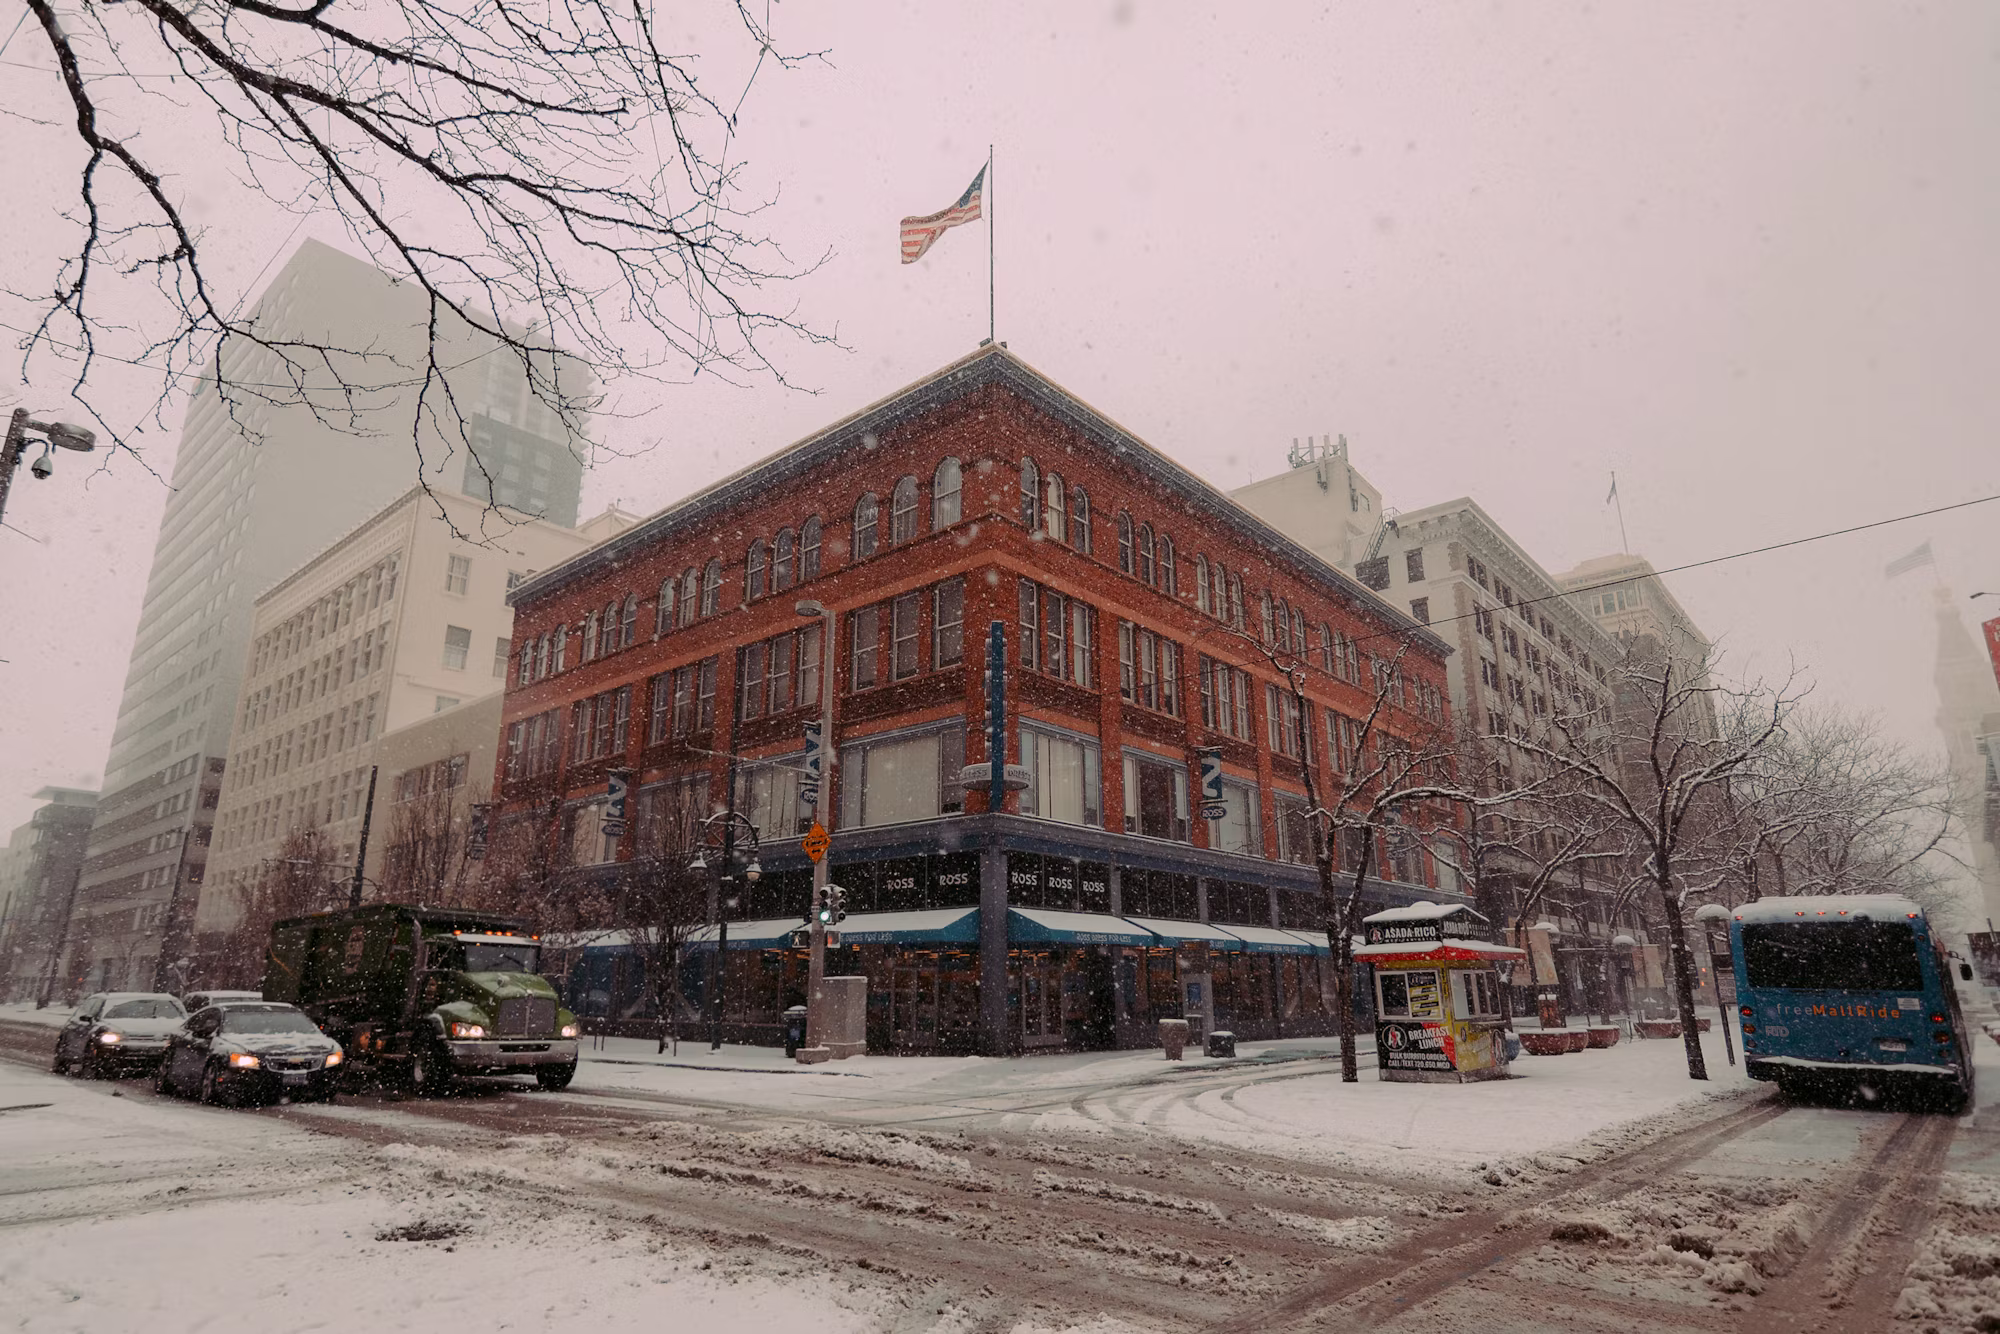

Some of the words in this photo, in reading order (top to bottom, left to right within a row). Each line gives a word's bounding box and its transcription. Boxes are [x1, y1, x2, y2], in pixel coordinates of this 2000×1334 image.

[1203, 809, 1224, 818] ROSS
[887, 878, 914, 890] ROSS
[940, 873, 968, 886] ROSS
[1011, 871, 1038, 886] ROSS
[1048, 877, 1073, 890] ROSS
[1082, 881, 1105, 893] ROSS
[1385, 926, 1413, 939] ASADA
[1414, 926, 1436, 937] RICO
[1408, 1026, 1449, 1041] BREAKFAST
[1419, 1037, 1445, 1049] LUNCH
